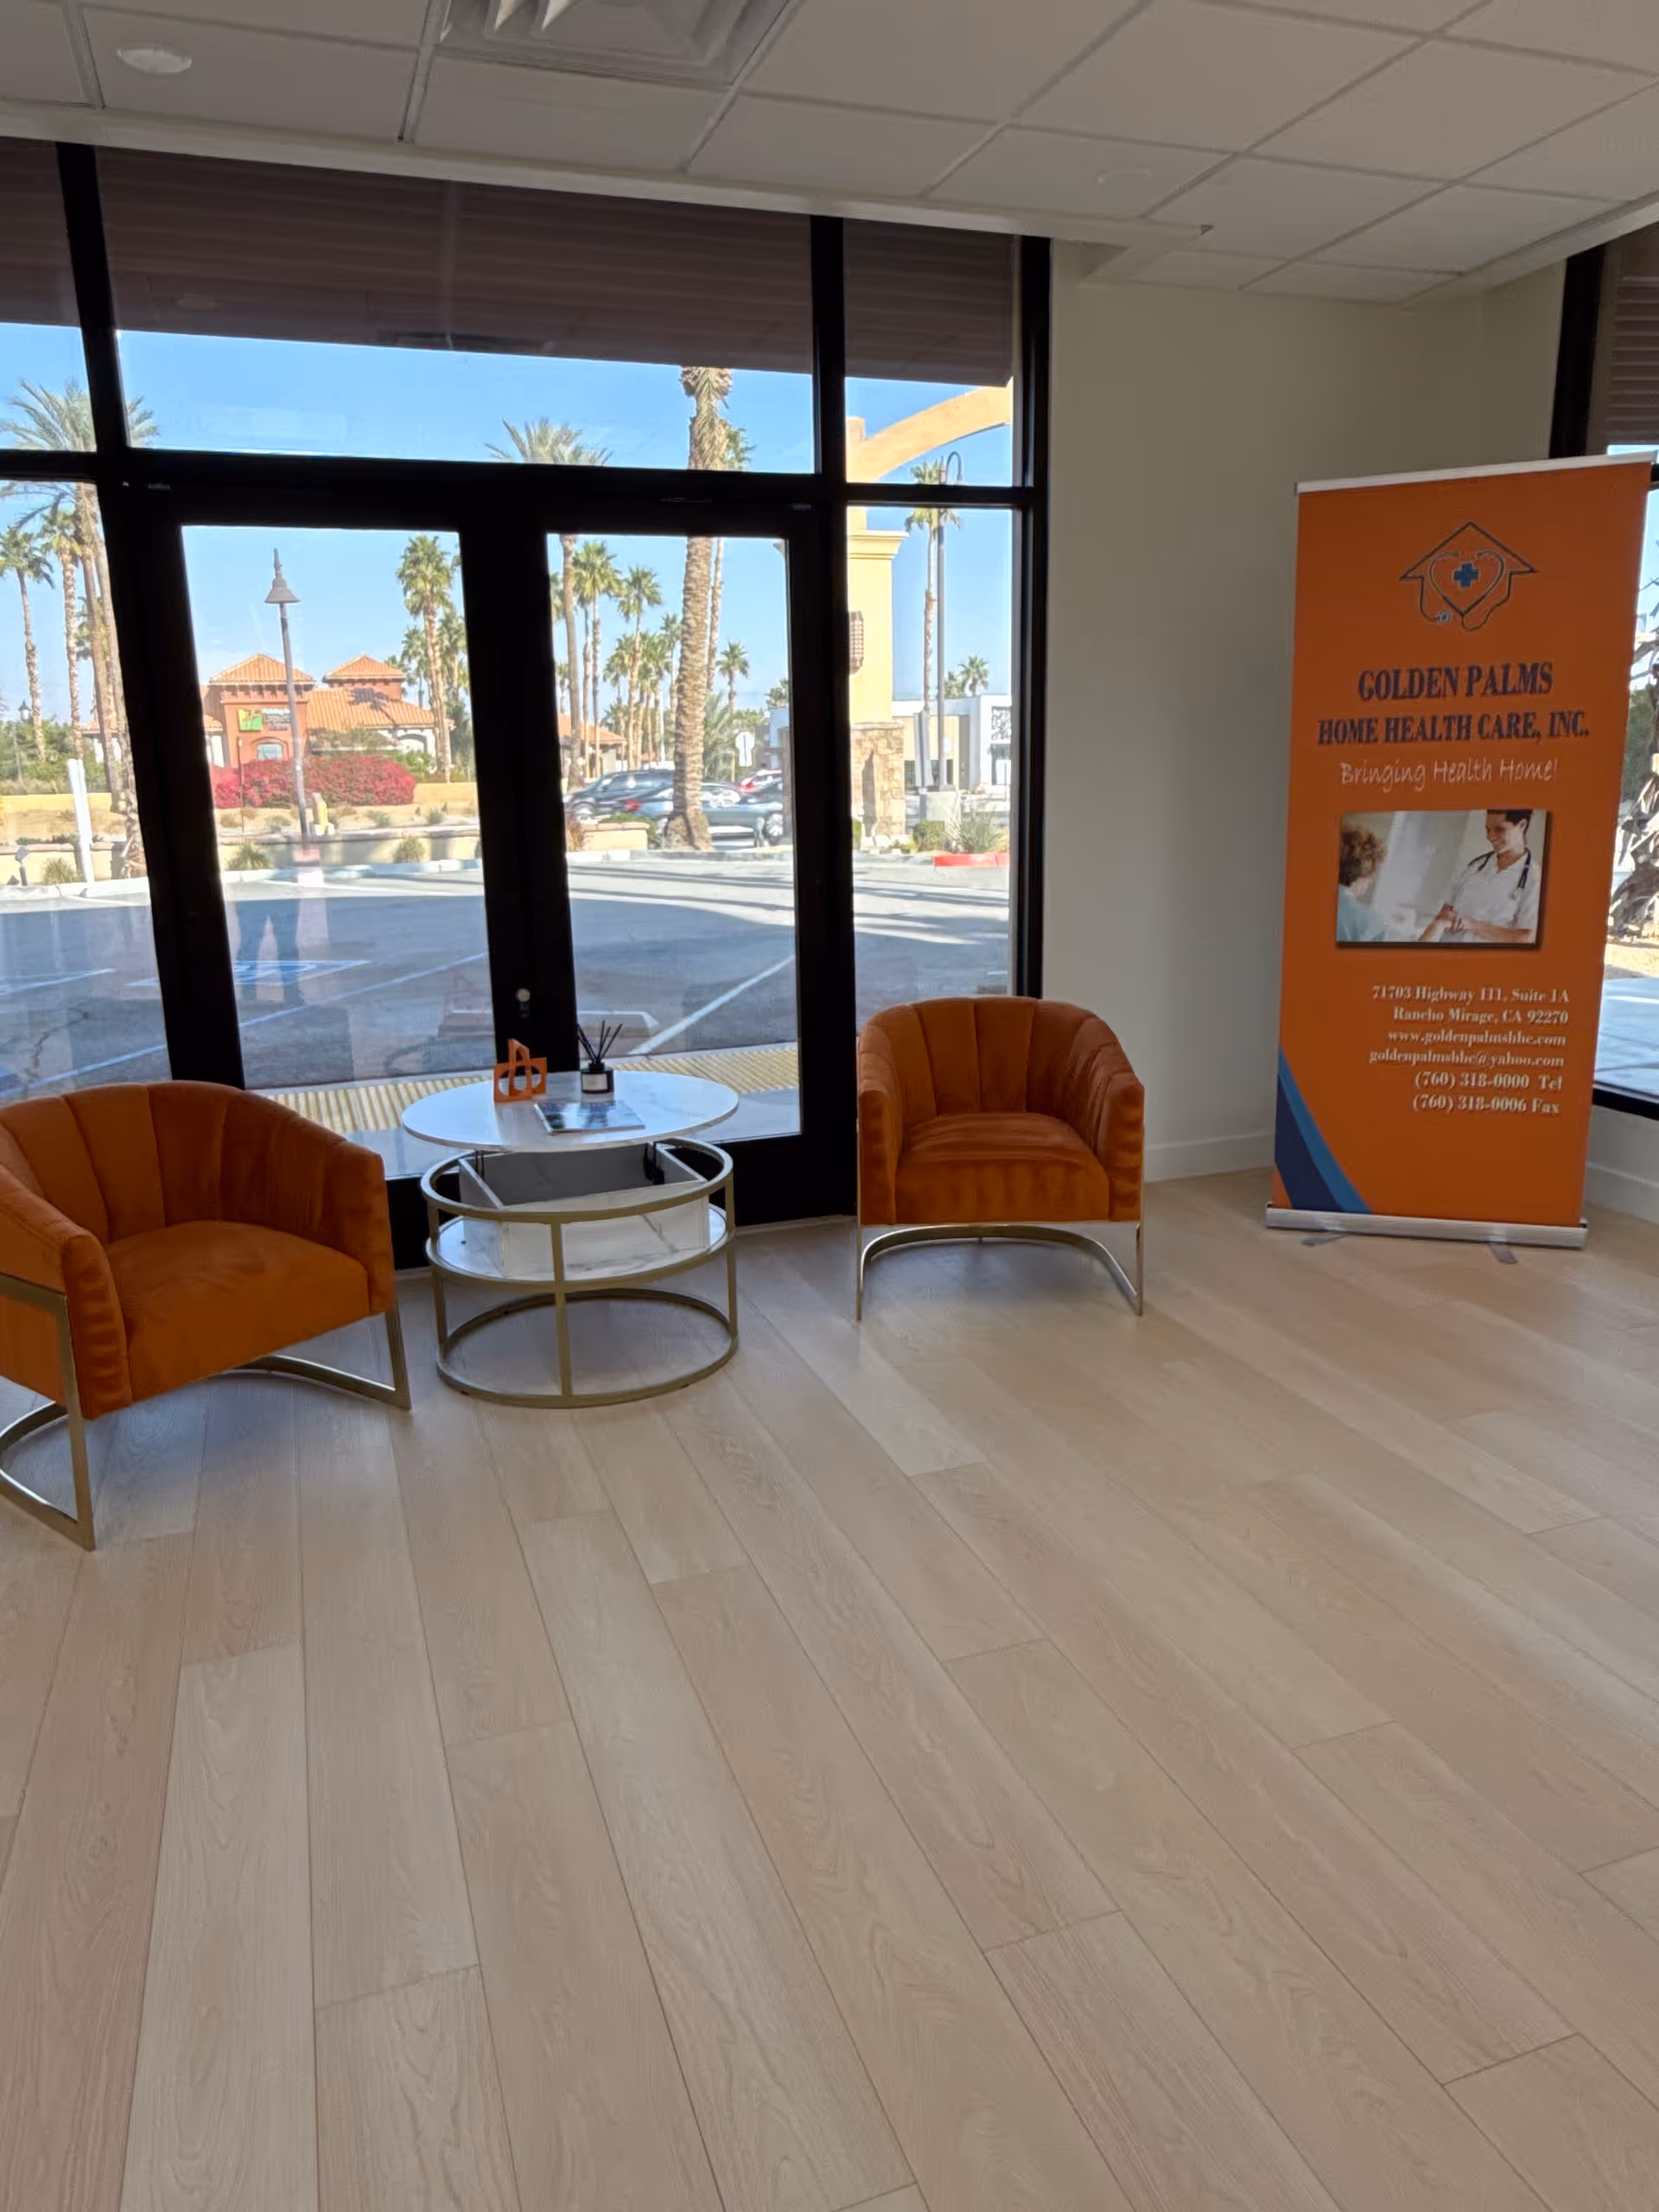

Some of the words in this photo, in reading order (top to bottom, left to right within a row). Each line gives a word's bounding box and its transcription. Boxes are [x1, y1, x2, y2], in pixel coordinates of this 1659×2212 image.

[1357, 664, 1460, 702] GOLDEN
[1465, 661, 1554, 698] PALMS
[1318, 717, 1379, 745] HOME
[1384, 714, 1472, 743] HEALTH
[1478, 711, 1542, 745] CARE,
[1547, 709, 1590, 738] INC.
[1340, 759, 1426, 793] Bringing
[1433, 756, 1493, 784] Health
[1499, 757, 1559, 783] Home!
[1372, 985, 1412, 1000] 71703
[1415, 986, 1475, 1005] Highway
[1511, 988, 1547, 1002] Suite
[1550, 988, 1570, 1003] 1A
[1393, 1006, 1445, 1021] Rancho
[1502, 1009, 1522, 1023] CA
[1527, 1009, 1569, 1025] 92270
[1414, 1071, 1456, 1090] (760)
[1459, 1072, 1530, 1090] 318-0000
[1538, 1074, 1563, 1092] Tel
[1412, 1094, 1454, 1114] (760)
[1457, 1095, 1528, 1112] 318-0006
[1531, 1097, 1560, 1115] Fax
